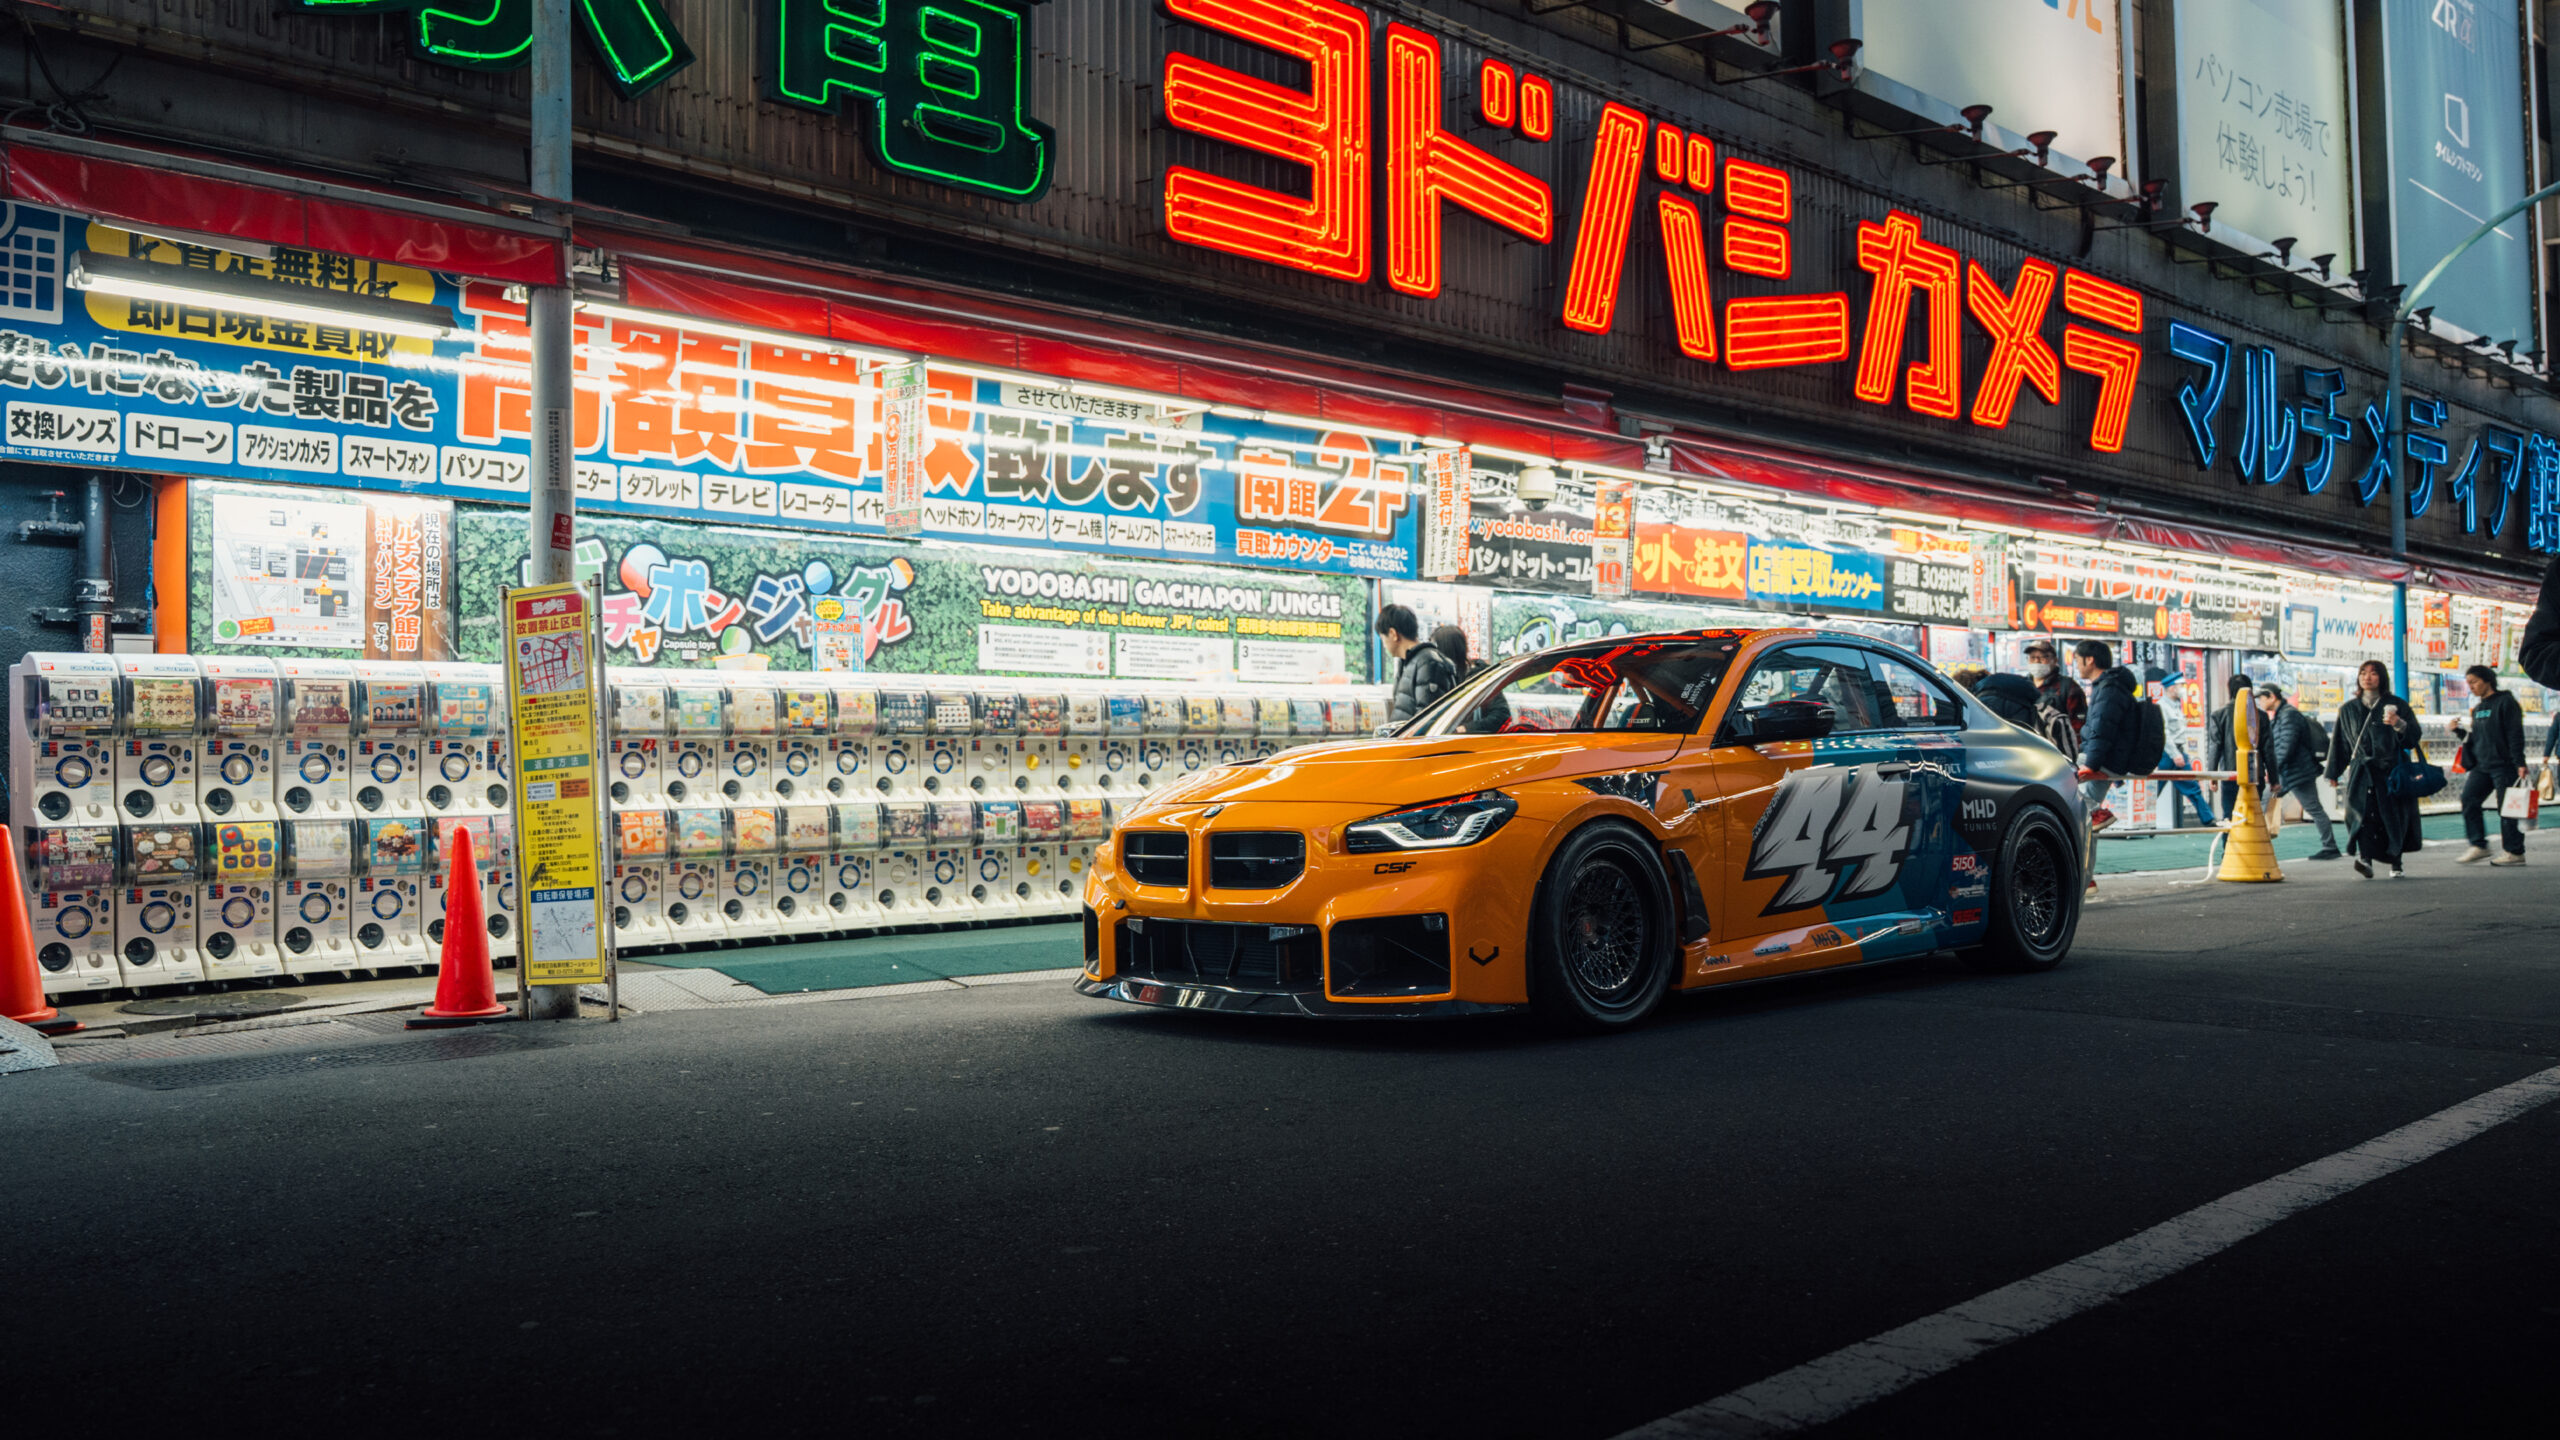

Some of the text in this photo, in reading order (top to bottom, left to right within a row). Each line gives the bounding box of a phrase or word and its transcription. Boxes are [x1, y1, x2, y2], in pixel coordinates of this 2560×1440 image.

[2196, 53, 2331, 158] パソコン売場で
[1163, 0, 2143, 453] ヨドバシカメラ
[1017, 387, 1143, 421] させていただきます
[11, 409, 117, 444] 交換レンズ
[135, 420, 227, 454] ドローン
[2168, 318, 2560, 556] マルチメディア館
[245, 433, 331, 466] アクションカメラ
[349, 443, 431, 475] スマートフォン
[444, 452, 526, 486] パソコン
[575, 472, 613, 491] ニター
[626, 473, 694, 501] タブレット
[708, 481, 771, 508] テレビ
[783, 489, 848, 515] レコーダー
[924, 505, 982, 529] ヘッドホン
[988, 508, 1047, 534] ウォークマン
[1051, 513, 1103, 539] ゲーム機
[1108, 519, 1160, 544] ゲームソフト
[1237, 529, 1349, 561] 買取カウンター
[980, 566, 1342, 618] YODOBASHI GACHAPON JUNGLE
[980, 599, 1230, 633] Take advantage of the leftover JPY coins!
[662, 638, 718, 653] Capsule toys
[983, 631, 991, 645] 1
[1120, 639, 1128, 653] 2
[1242, 643, 1250, 658] 3
[1962, 798, 1997, 820] MHD
[1745, 764, 1911, 915] 44
[1963, 822, 1998, 832] TUNING
[1373, 860, 1417, 875] CSF
[1952, 855, 1976, 871] 5150
